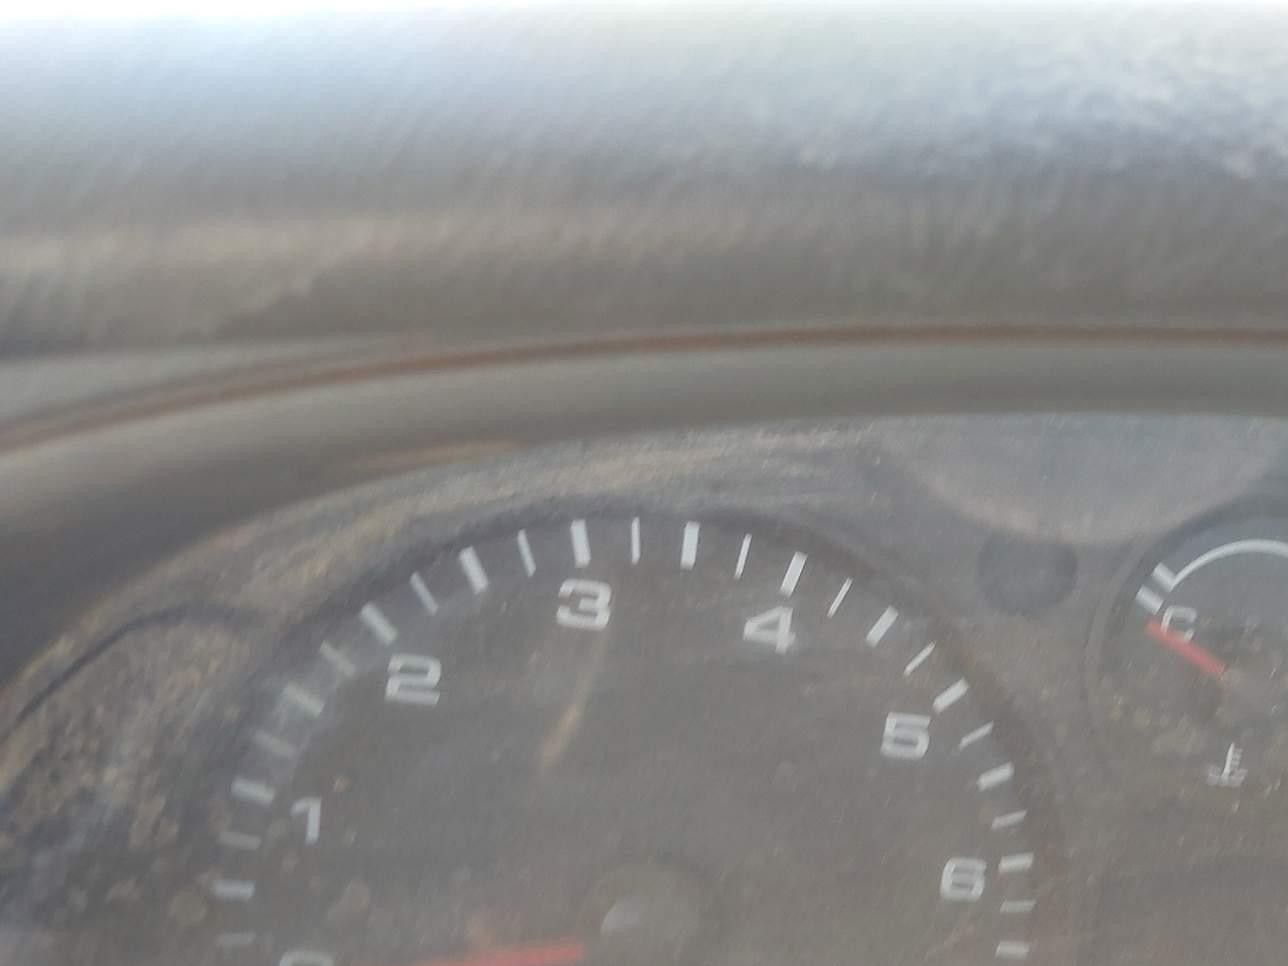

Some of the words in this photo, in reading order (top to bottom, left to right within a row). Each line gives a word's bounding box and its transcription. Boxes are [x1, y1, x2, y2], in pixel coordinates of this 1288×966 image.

[556, 578, 614, 633] 3
[1159, 603, 1197, 642] C
[743, 606, 796, 655] 4
[384, 653, 443, 706] 2
[880, 711, 932, 760] 5
[291, 798, 322, 844] 1
[940, 857, 987, 903] 6
